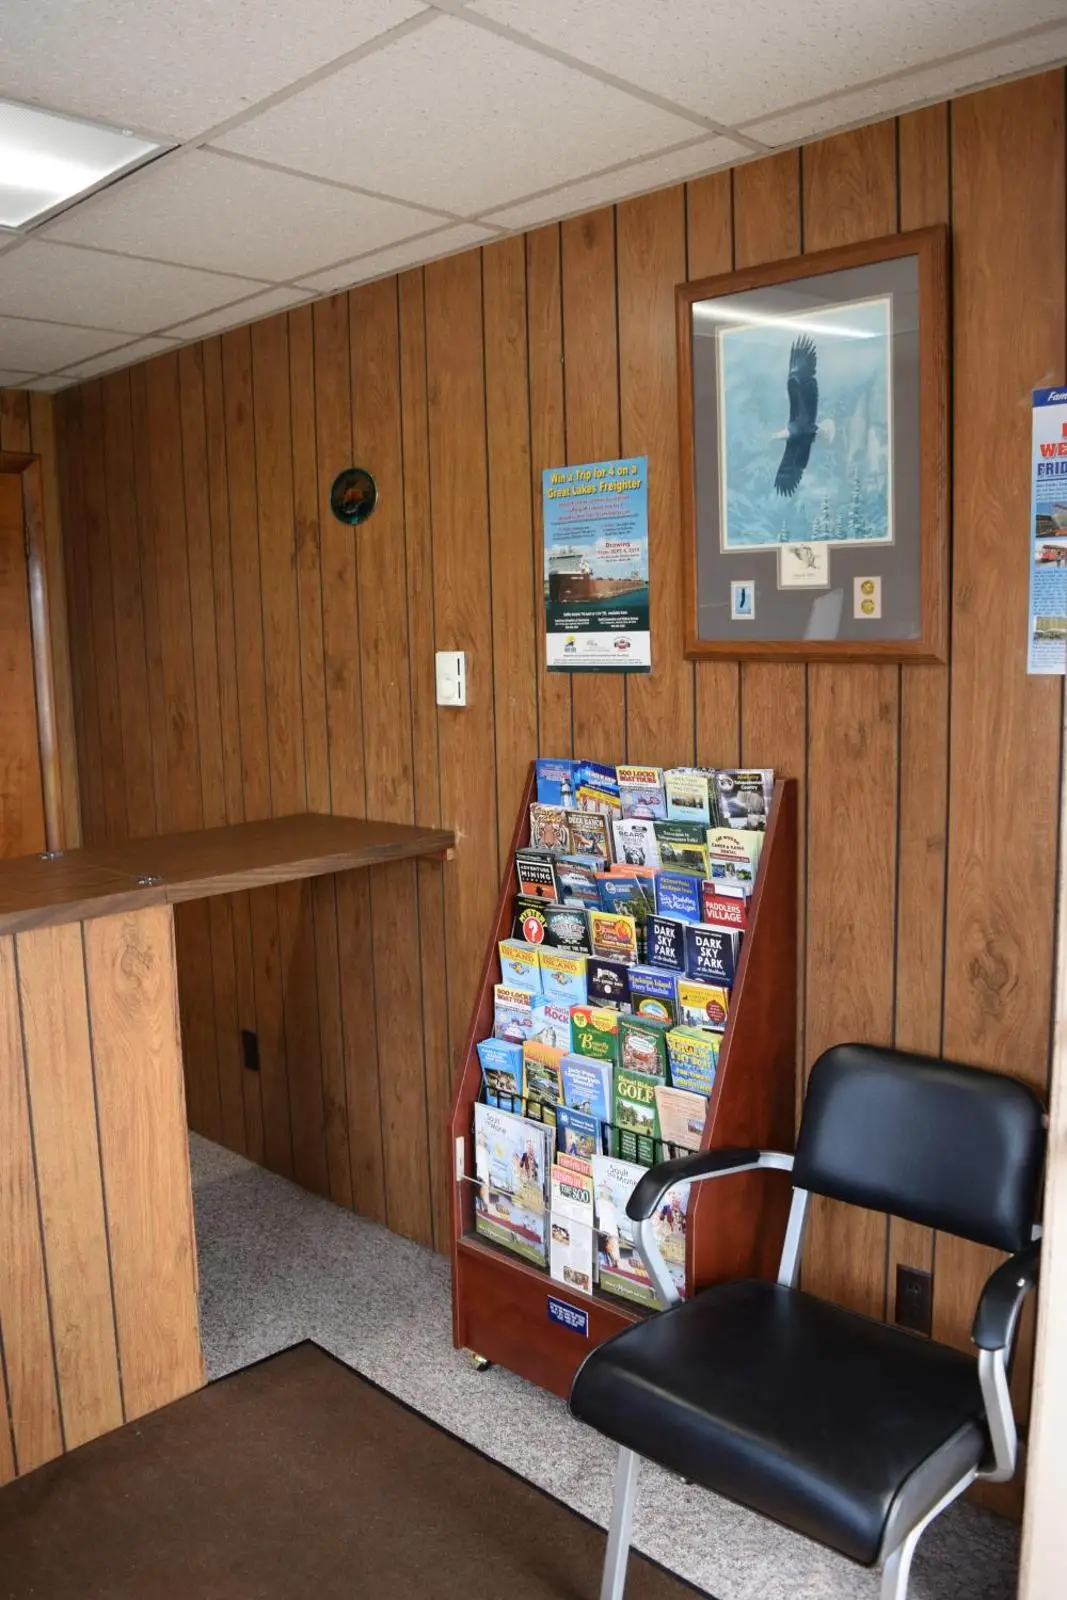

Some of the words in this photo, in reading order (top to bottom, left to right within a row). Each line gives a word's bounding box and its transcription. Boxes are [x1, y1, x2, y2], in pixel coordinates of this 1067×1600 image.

[551, 472, 565, 484] Win
[568, 474, 573, 482] a
[576, 471, 591, 482] Trip
[594, 467, 607, 478] for
[608, 467, 615, 476] 4
[618, 467, 629, 476] on
[632, 464, 638, 473] a
[548, 487, 570, 499] Great
[572, 485, 596, 496] Lakes
[599, 479, 642, 494] Freighter
[520, 864, 551, 874] ADVENTURE
[520, 871, 552, 881] MINING
[705, 900, 742, 914] PADDLERS
[705, 909, 743, 924] VILLAGE
[653, 924, 676, 939] DARK
[657, 935, 673, 947] SKY
[695, 935, 723, 951] DARK
[653, 944, 676, 959] PARK
[700, 947, 719, 959] SKY
[697, 956, 724, 971] PARK
[618, 1082, 655, 1104] GOLF
